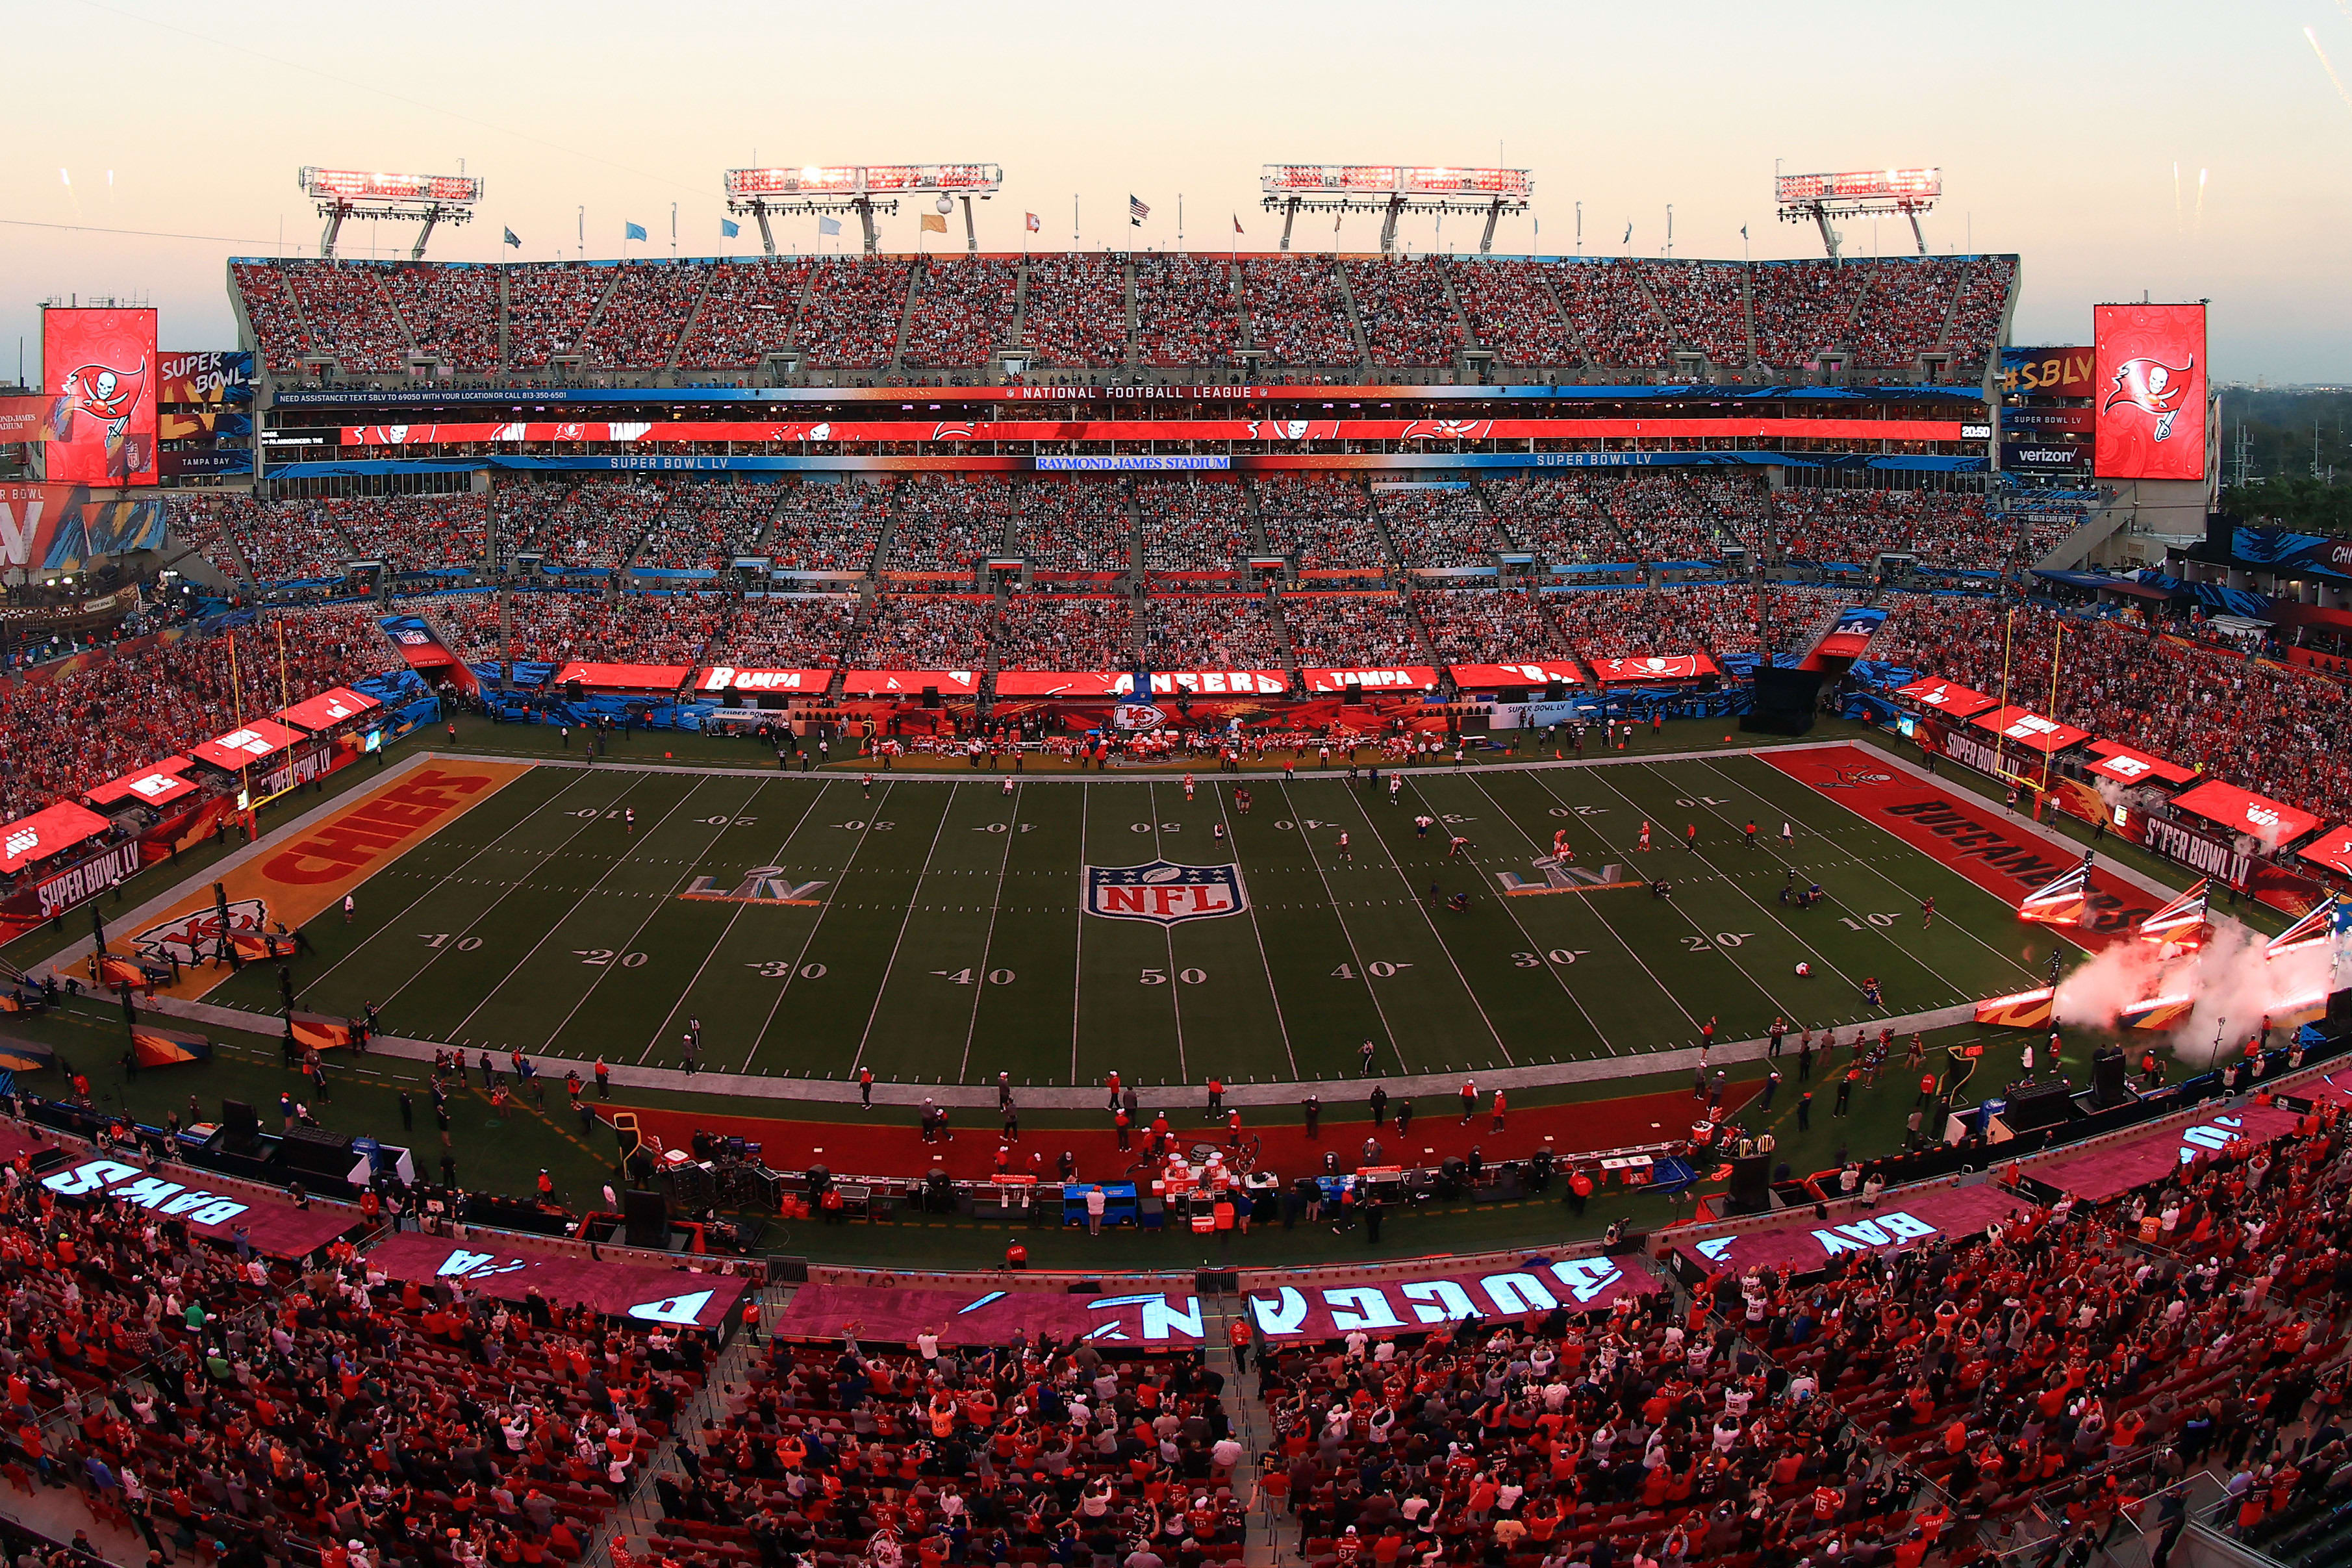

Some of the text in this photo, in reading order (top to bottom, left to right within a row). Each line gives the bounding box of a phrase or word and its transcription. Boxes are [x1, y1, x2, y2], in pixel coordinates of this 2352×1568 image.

[162, 353, 222, 381] SUPER
[2002, 354, 2095, 392] #SBLV
[195, 367, 246, 394] BOWL
[1023, 387, 1251, 399] NATIONAL FOOTBALL LEAGUE
[1962, 426, 1990, 438] 20:50
[611, 458, 728, 468] SUPER BOWL LV
[1039, 457, 1228, 469] RAYMOND JAMES STADIUM
[1537, 453, 1652, 466] SUPER BOWL LV
[2019, 448, 2071, 462] verizon
[12, 488, 44, 499] BOWL
[1508, 704, 1532, 713] SUPER
[319, 746, 331, 775] LV
[1946, 732, 1977, 766] SUPER
[2005, 759, 2020, 785] LV
[1675, 796, 1720, 807] 10
[577, 807, 622, 820] 10
[1549, 805, 1598, 816] 20
[262, 770, 492, 885] CHIEFS
[705, 815, 759, 827] 20
[844, 819, 896, 832] 30
[987, 822, 1038, 834] 40
[1130, 822, 1181, 834] 50
[1274, 819, 1324, 831] 40
[2145, 816, 2251, 887] SUPER BOWL LV
[38, 841, 140, 918] SUPER BOWL LV
[1103, 885, 1228, 917] NFL
[1838, 912, 1895, 931] 10
[425, 933, 484, 952] 10
[1680, 931, 1744, 953] 20
[581, 948, 648, 968] 20
[1511, 948, 1576, 968] 30
[759, 960, 828, 980] 30
[947, 967, 1016, 985] 40
[1139, 967, 1208, 985] 50
[1331, 960, 1397, 980] 40
[1815, 1498, 1828, 1511] 15
[1925, 1519, 1943, 1527] STAFF
